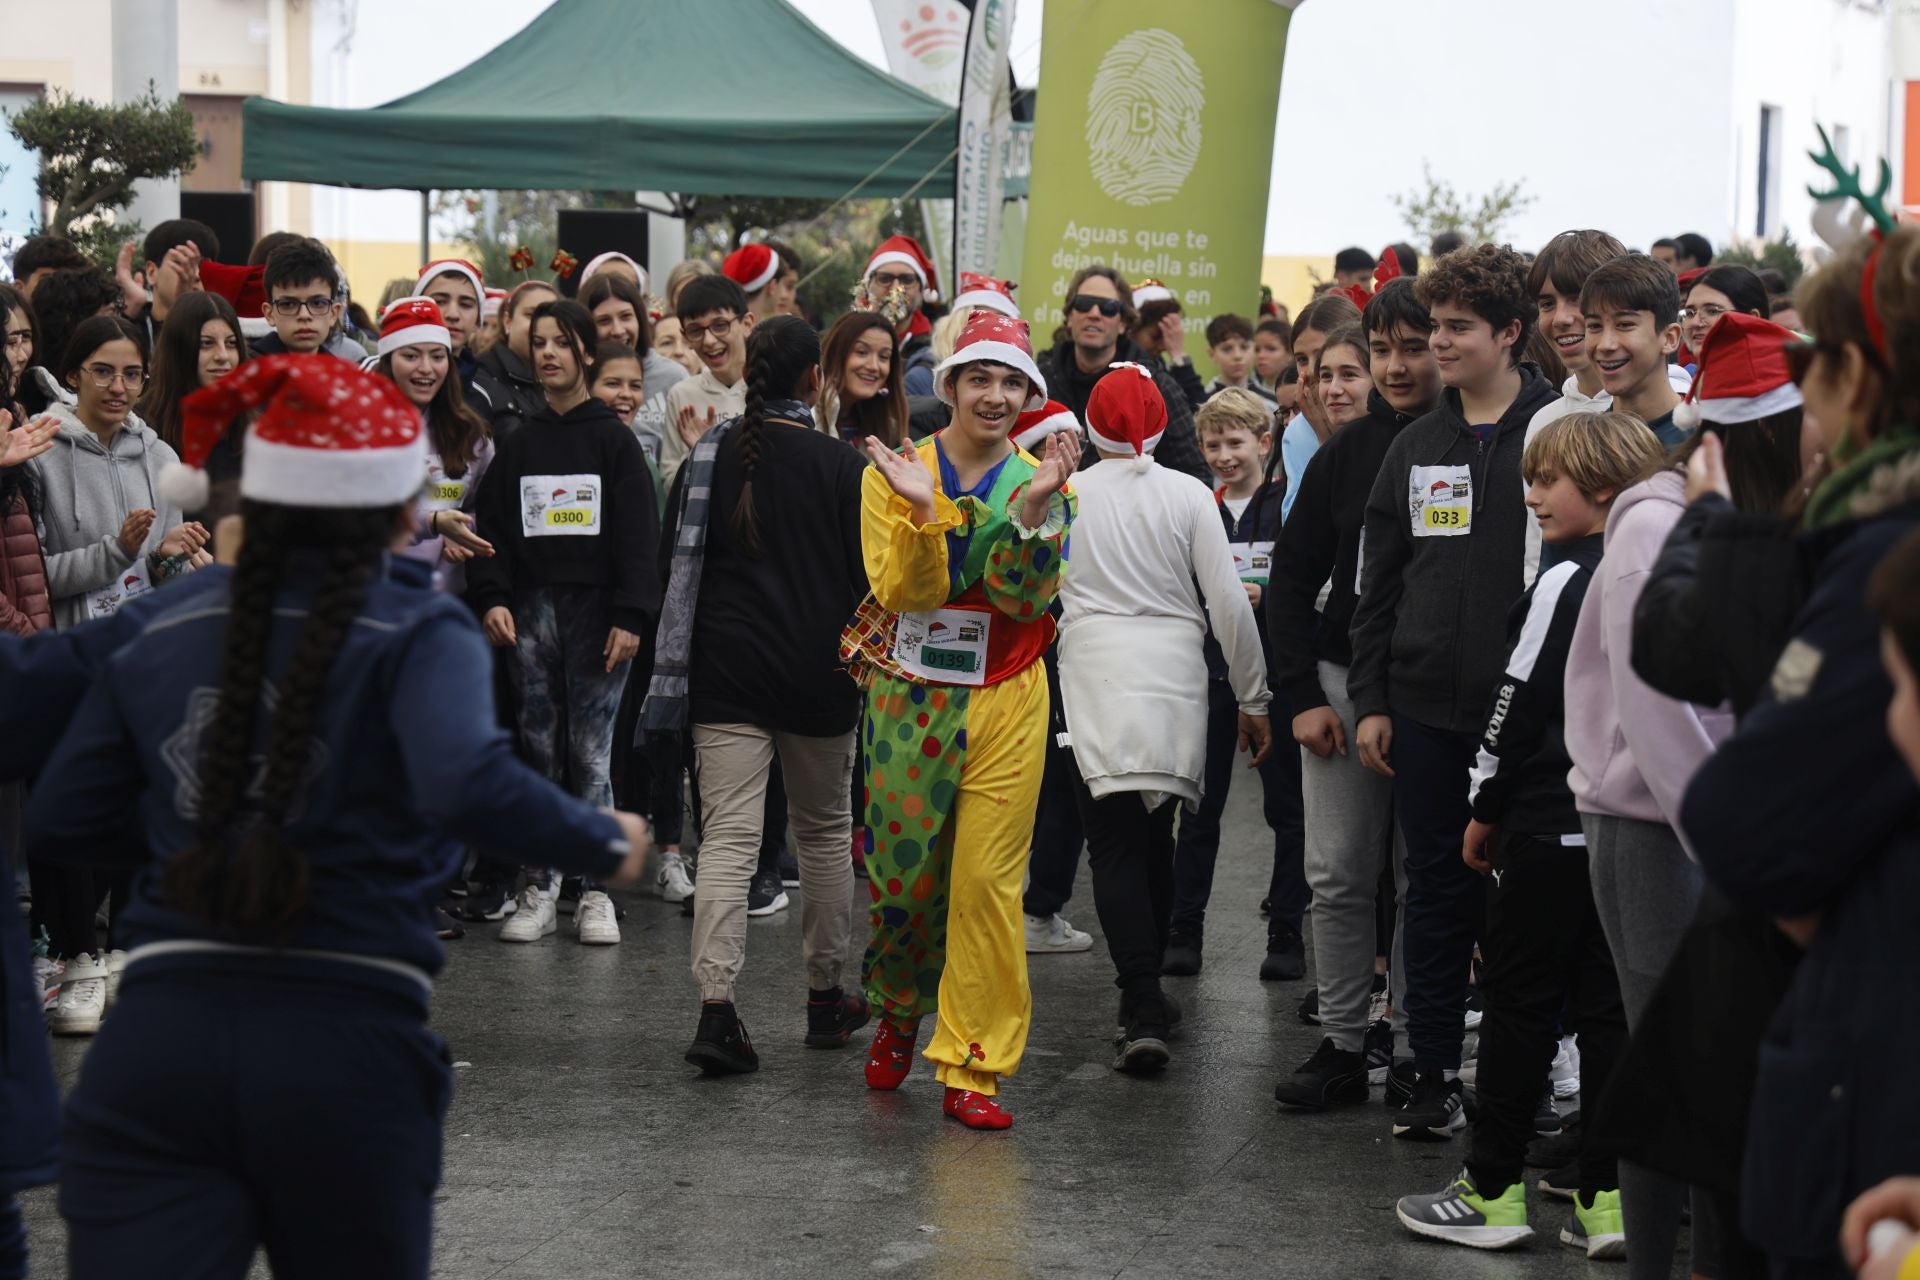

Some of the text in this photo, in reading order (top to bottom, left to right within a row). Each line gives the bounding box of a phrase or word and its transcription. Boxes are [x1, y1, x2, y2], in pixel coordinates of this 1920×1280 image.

[1132, 102, 1153, 132] B
[1063, 221, 1208, 251] Aguas que te
[1051, 247, 1216, 277] dejan huella sin
[1184, 289, 1211, 305] en
[1033, 301, 1047, 322] el
[433, 486, 459, 498] 0306
[553, 512, 584, 523] 0300
[927, 651, 965, 668] 0139
[1485, 684, 1516, 747] Joma
